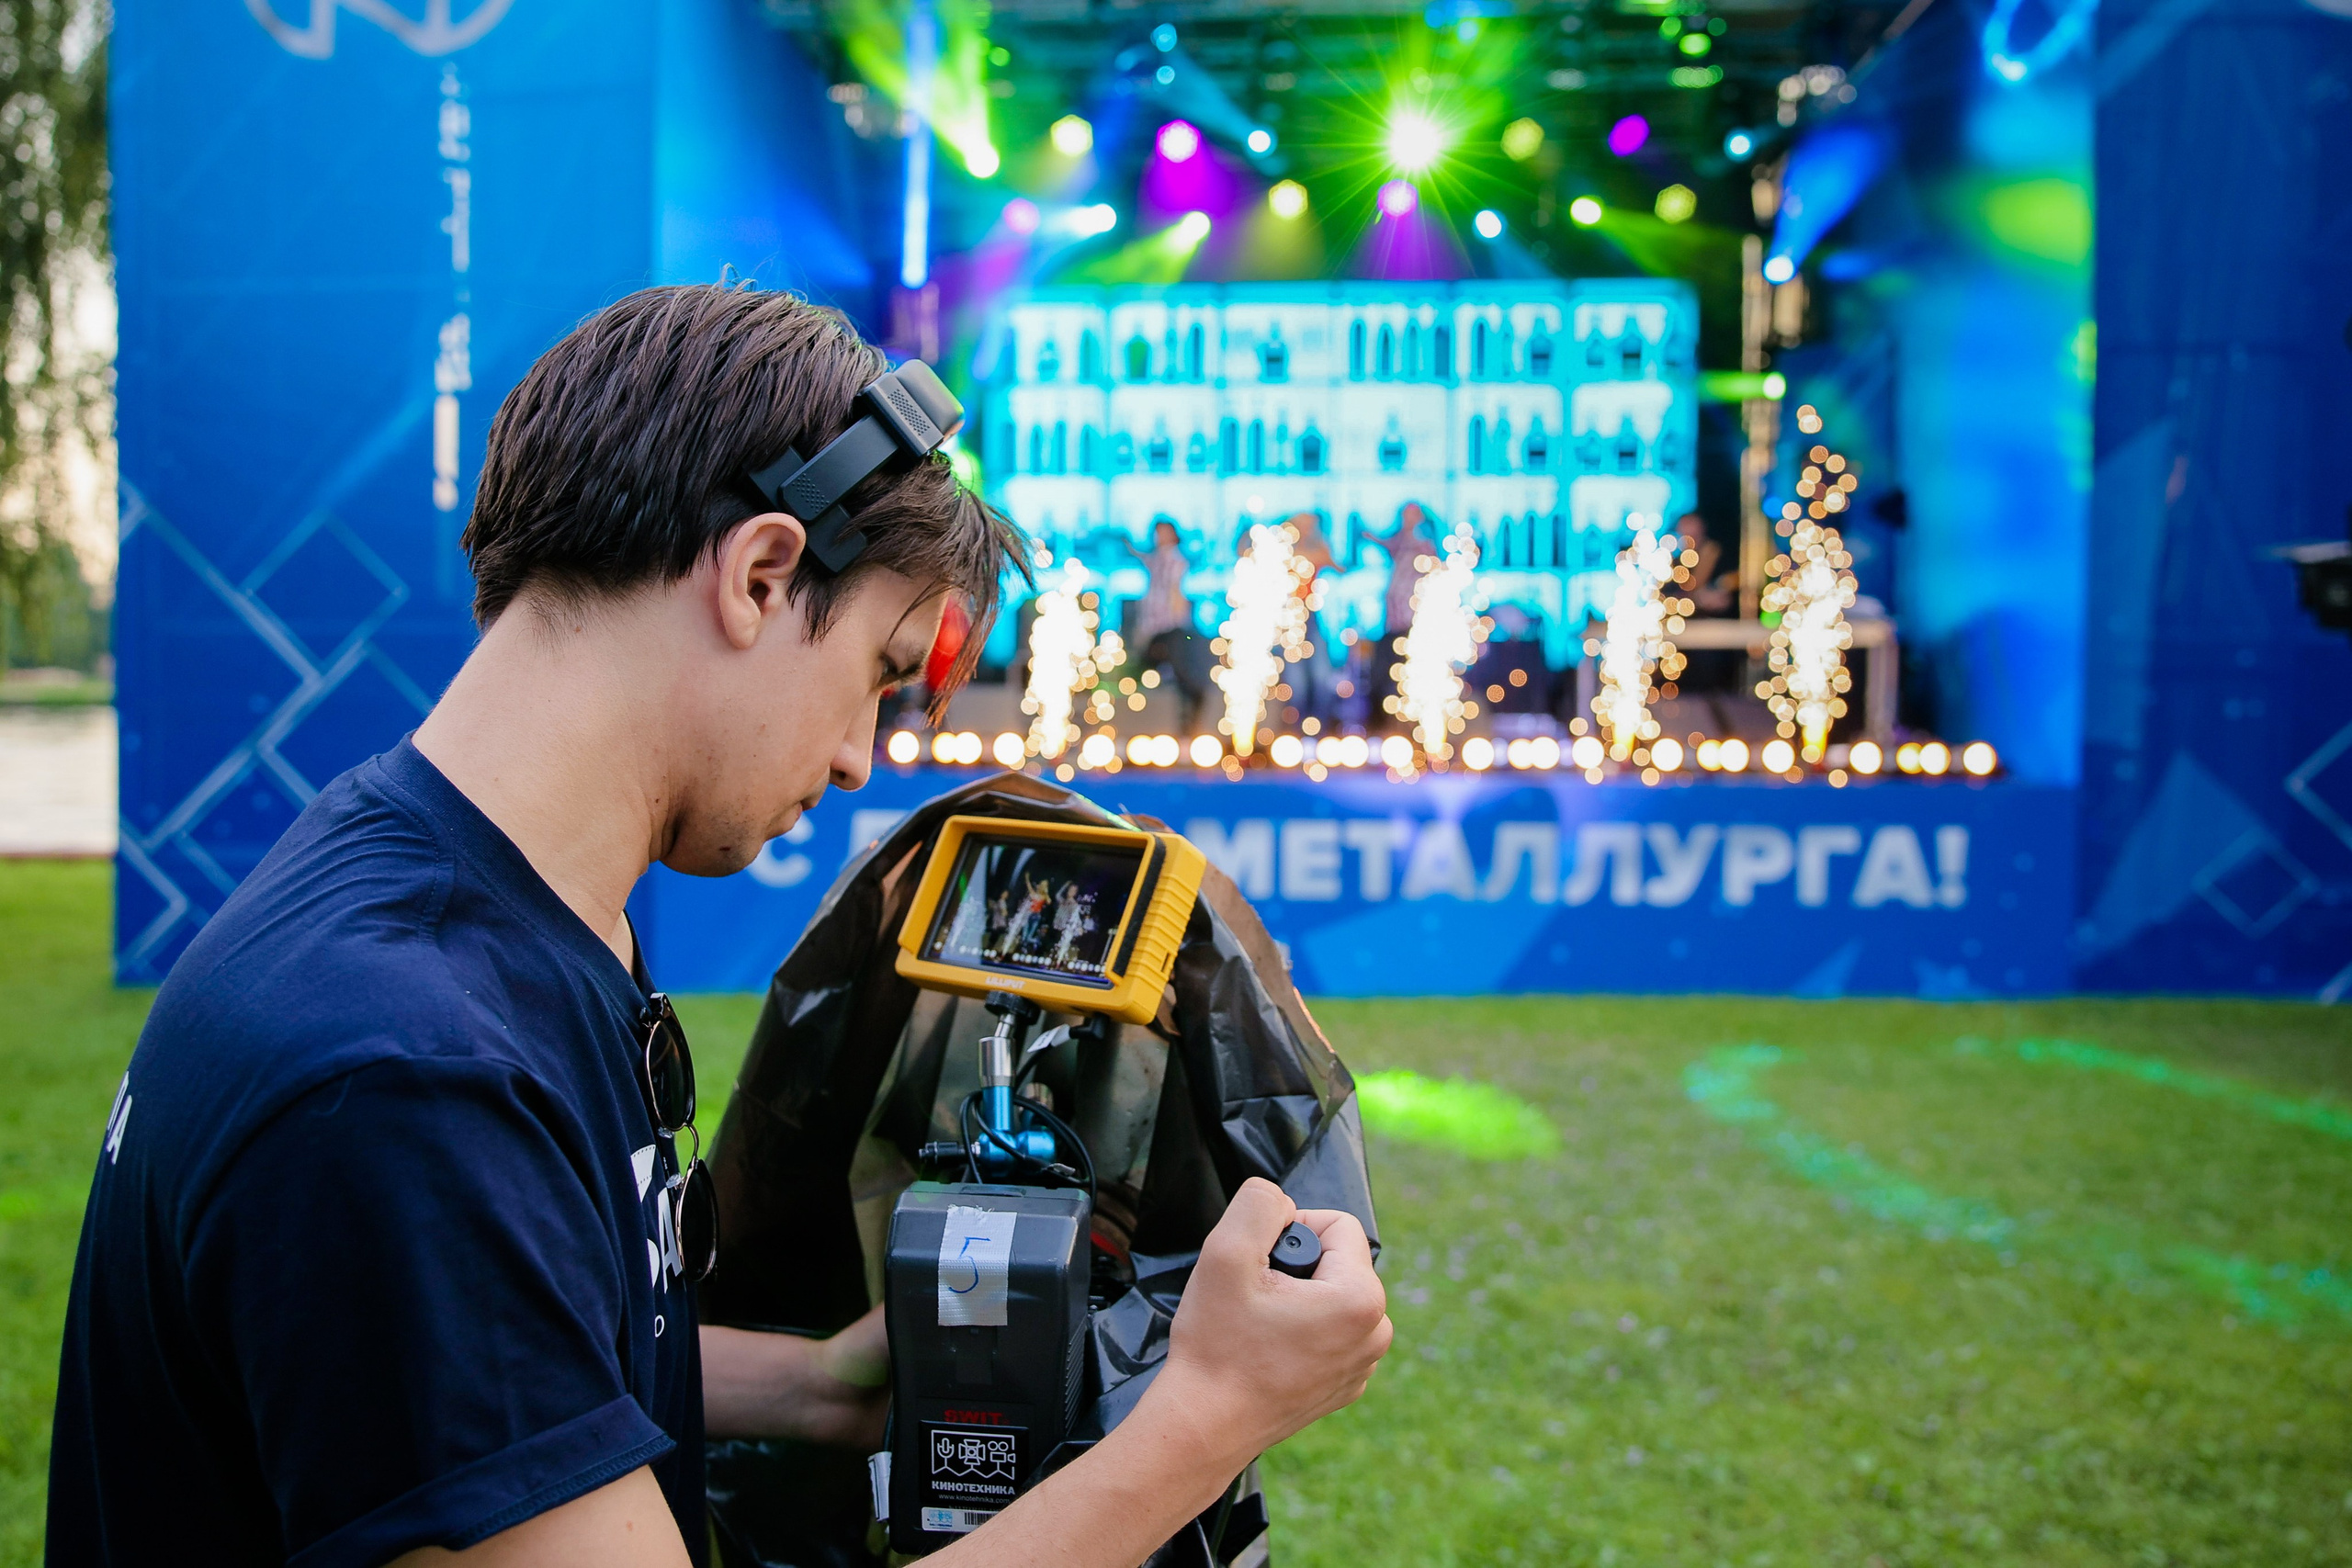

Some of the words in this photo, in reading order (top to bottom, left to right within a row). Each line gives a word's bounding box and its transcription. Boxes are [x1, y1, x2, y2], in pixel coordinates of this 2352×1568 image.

[1181, 818, 1970, 908] МЕТАЛЛУРГА!
[986, 976, 1025, 989] LILLIPUT
[948, 1236, 991, 1293] 5
[944, 1410, 1002, 1425] SWIT
[932, 1481, 1015, 1495] КИНОТЕХНИКА
